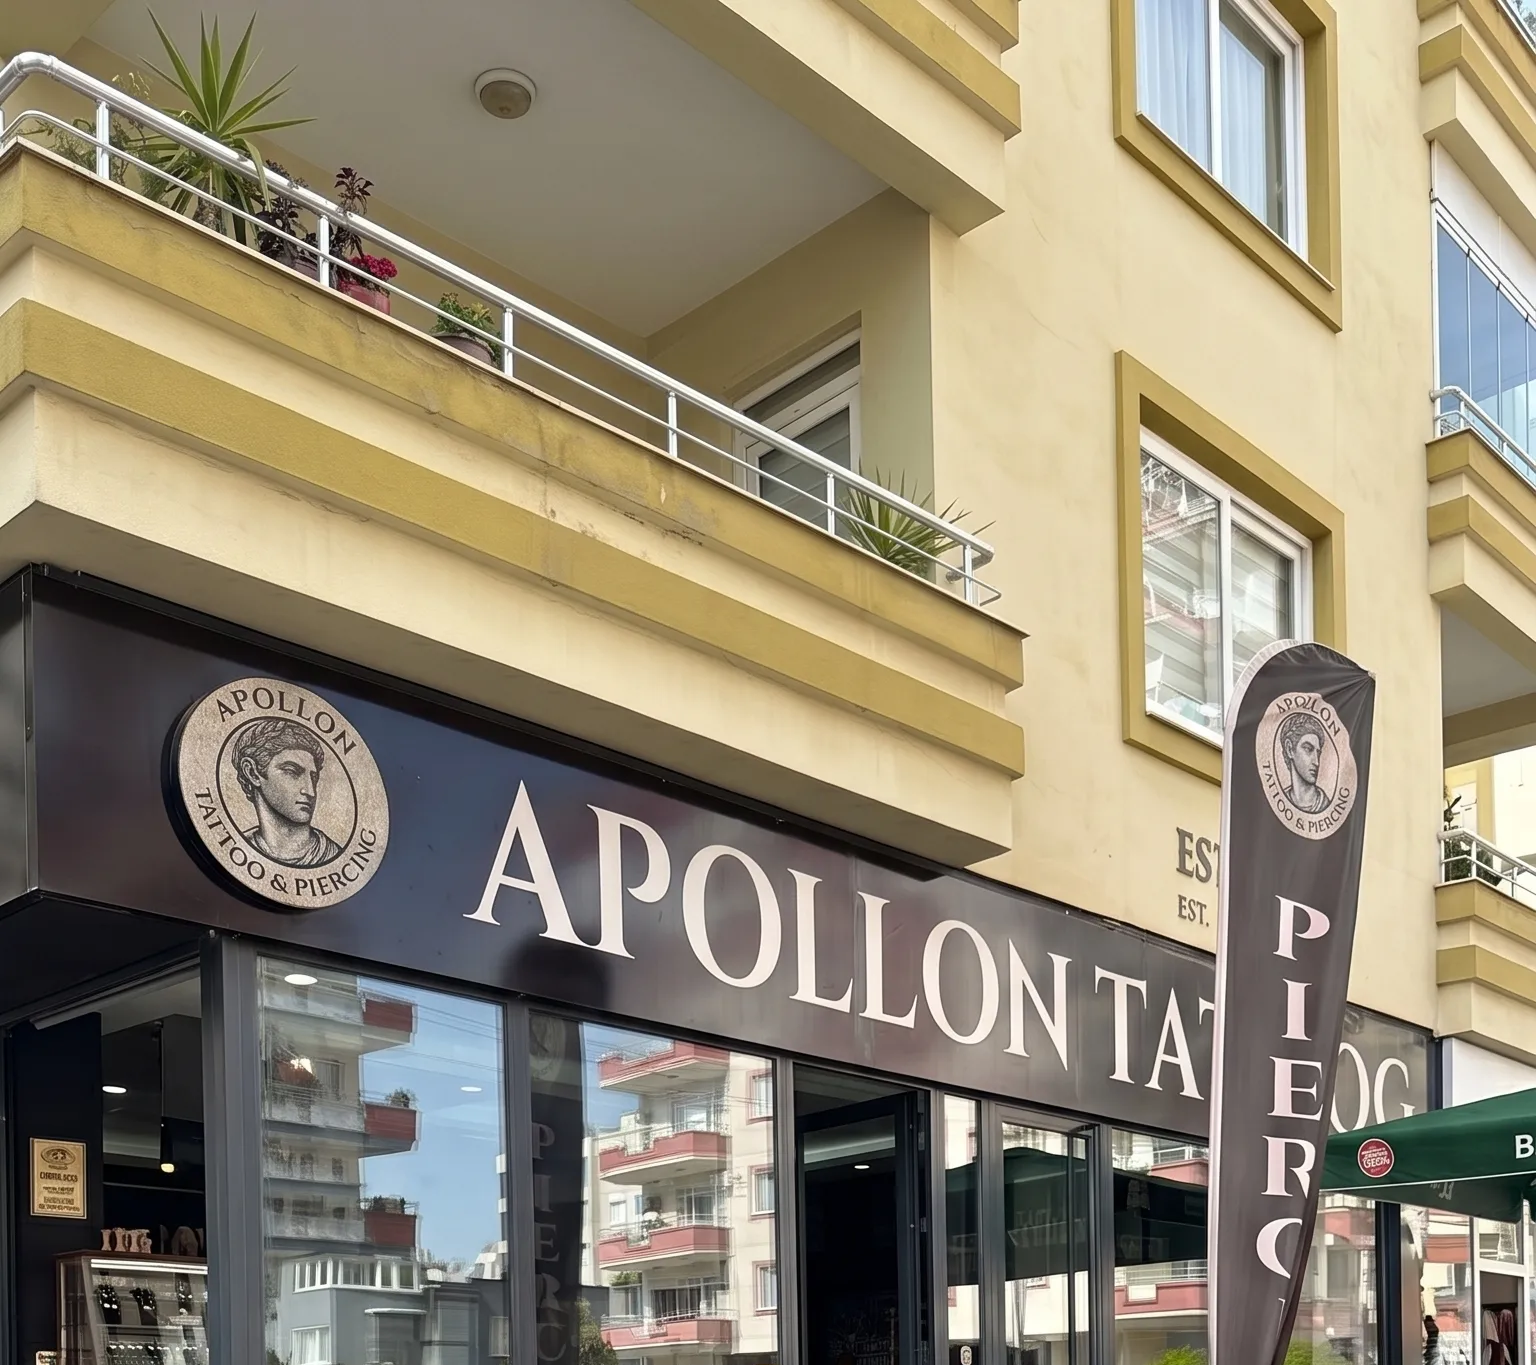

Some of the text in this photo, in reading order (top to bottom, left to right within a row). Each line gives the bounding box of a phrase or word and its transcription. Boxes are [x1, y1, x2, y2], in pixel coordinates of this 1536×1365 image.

[216, 687, 357, 755] APOLLON
[1275, 695, 1340, 737] APOLLON
[1263, 760, 1350, 833] TATTOO & PIERCING
[194, 787, 377, 897] TATTOO & PIERCING
[462, 779, 1073, 1070] APOLLON
[1095, 965, 1216, 1101] TA
[1177, 894, 1209, 927] EST.
[1515, 1134, 1536, 1160] B
